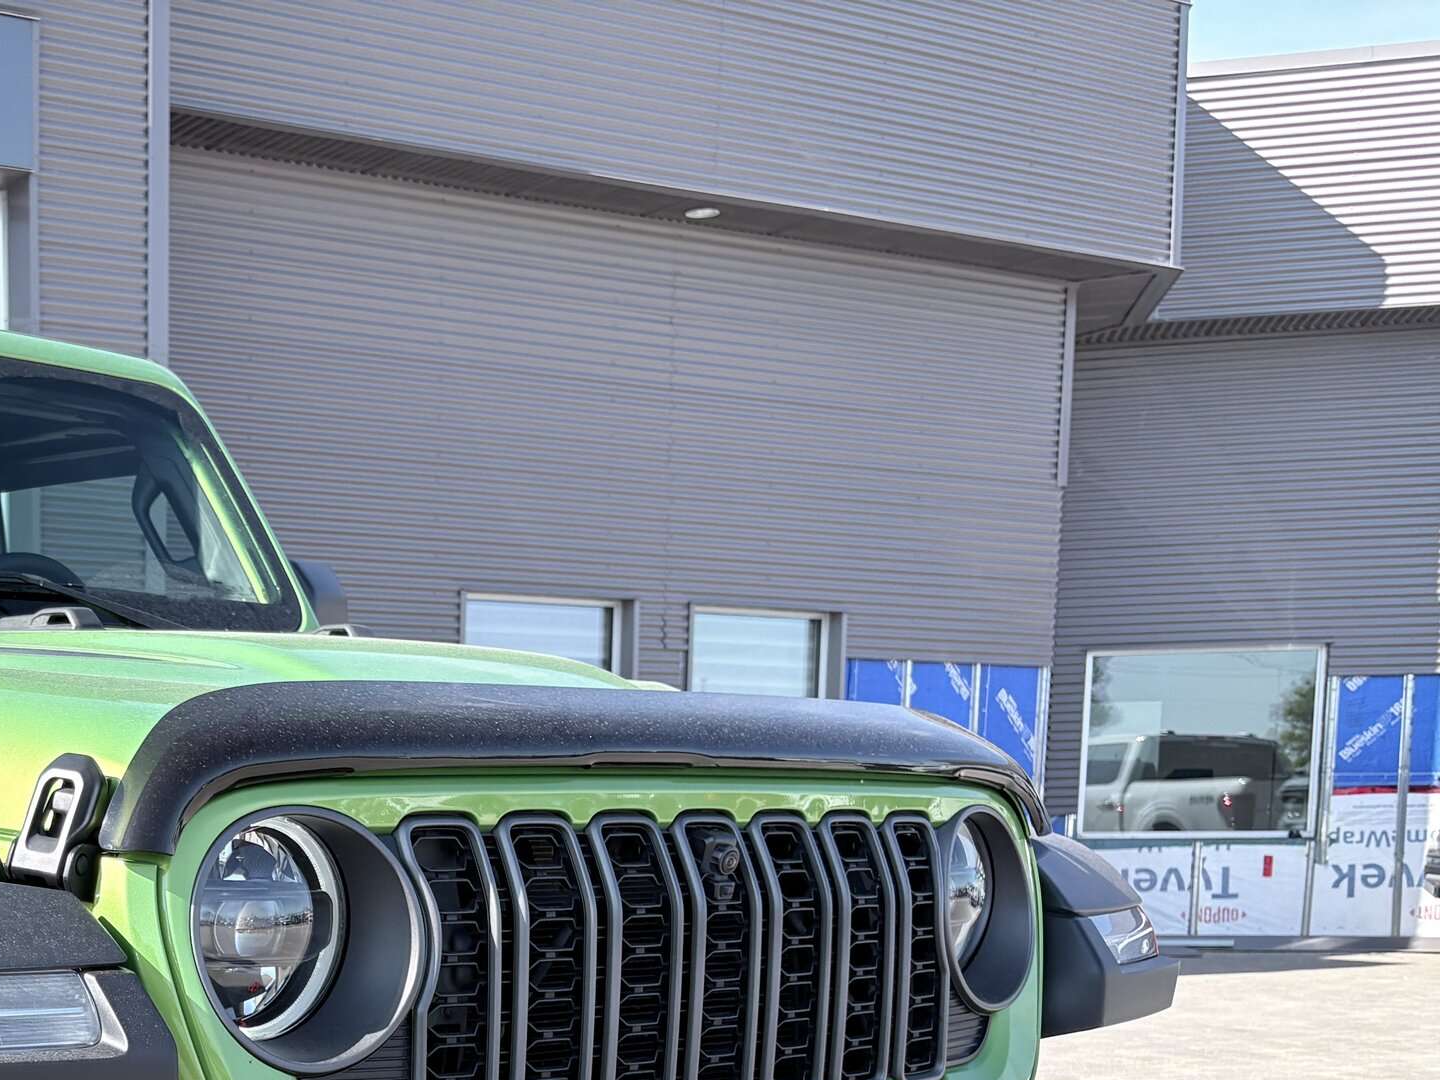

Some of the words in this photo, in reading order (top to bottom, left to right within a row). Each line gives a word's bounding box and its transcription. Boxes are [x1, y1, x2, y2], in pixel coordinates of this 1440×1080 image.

[1327, 827, 1438, 848] mWrap
[1120, 856, 1239, 899] Tyve
[1331, 863, 1424, 898] vek
[1197, 905, 1240, 924] DUPON
